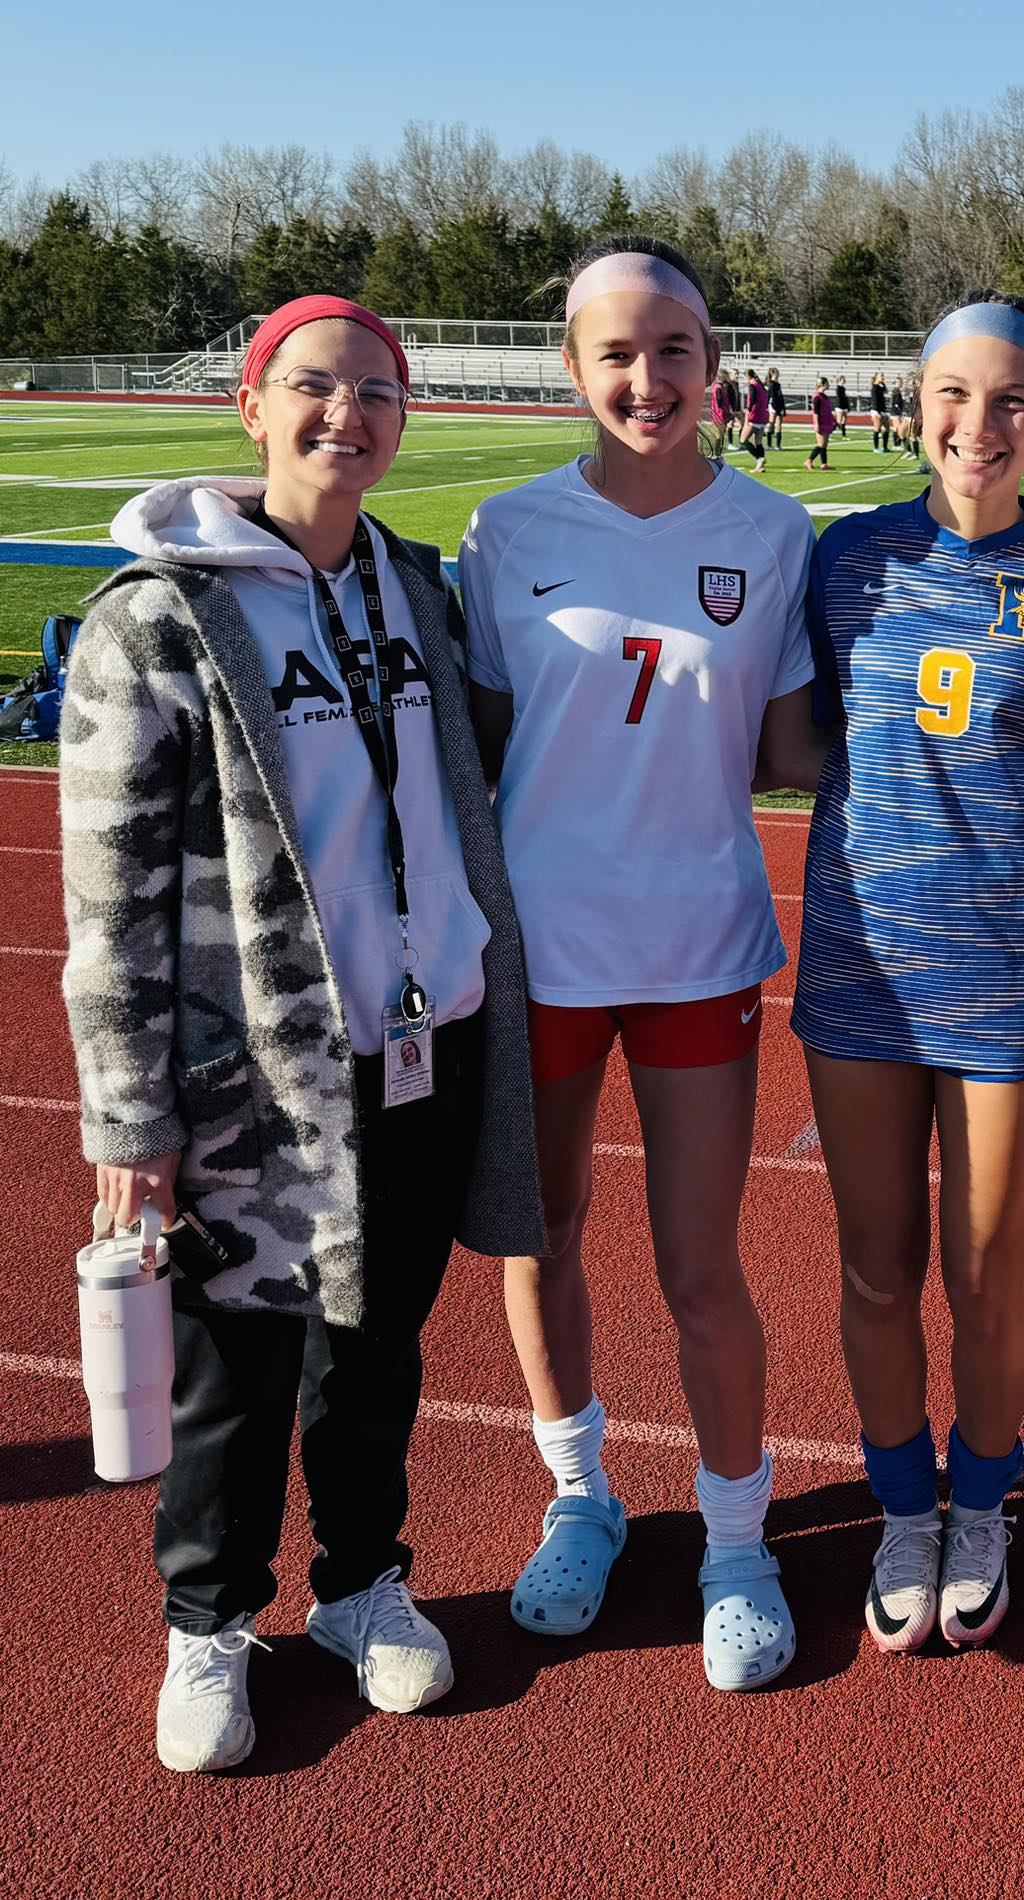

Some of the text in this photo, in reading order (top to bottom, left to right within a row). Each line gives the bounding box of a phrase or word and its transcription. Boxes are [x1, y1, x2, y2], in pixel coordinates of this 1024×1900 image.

[708, 574, 736, 587] LHS
[622, 636, 662, 724] 7
[915, 646, 976, 738] 9
